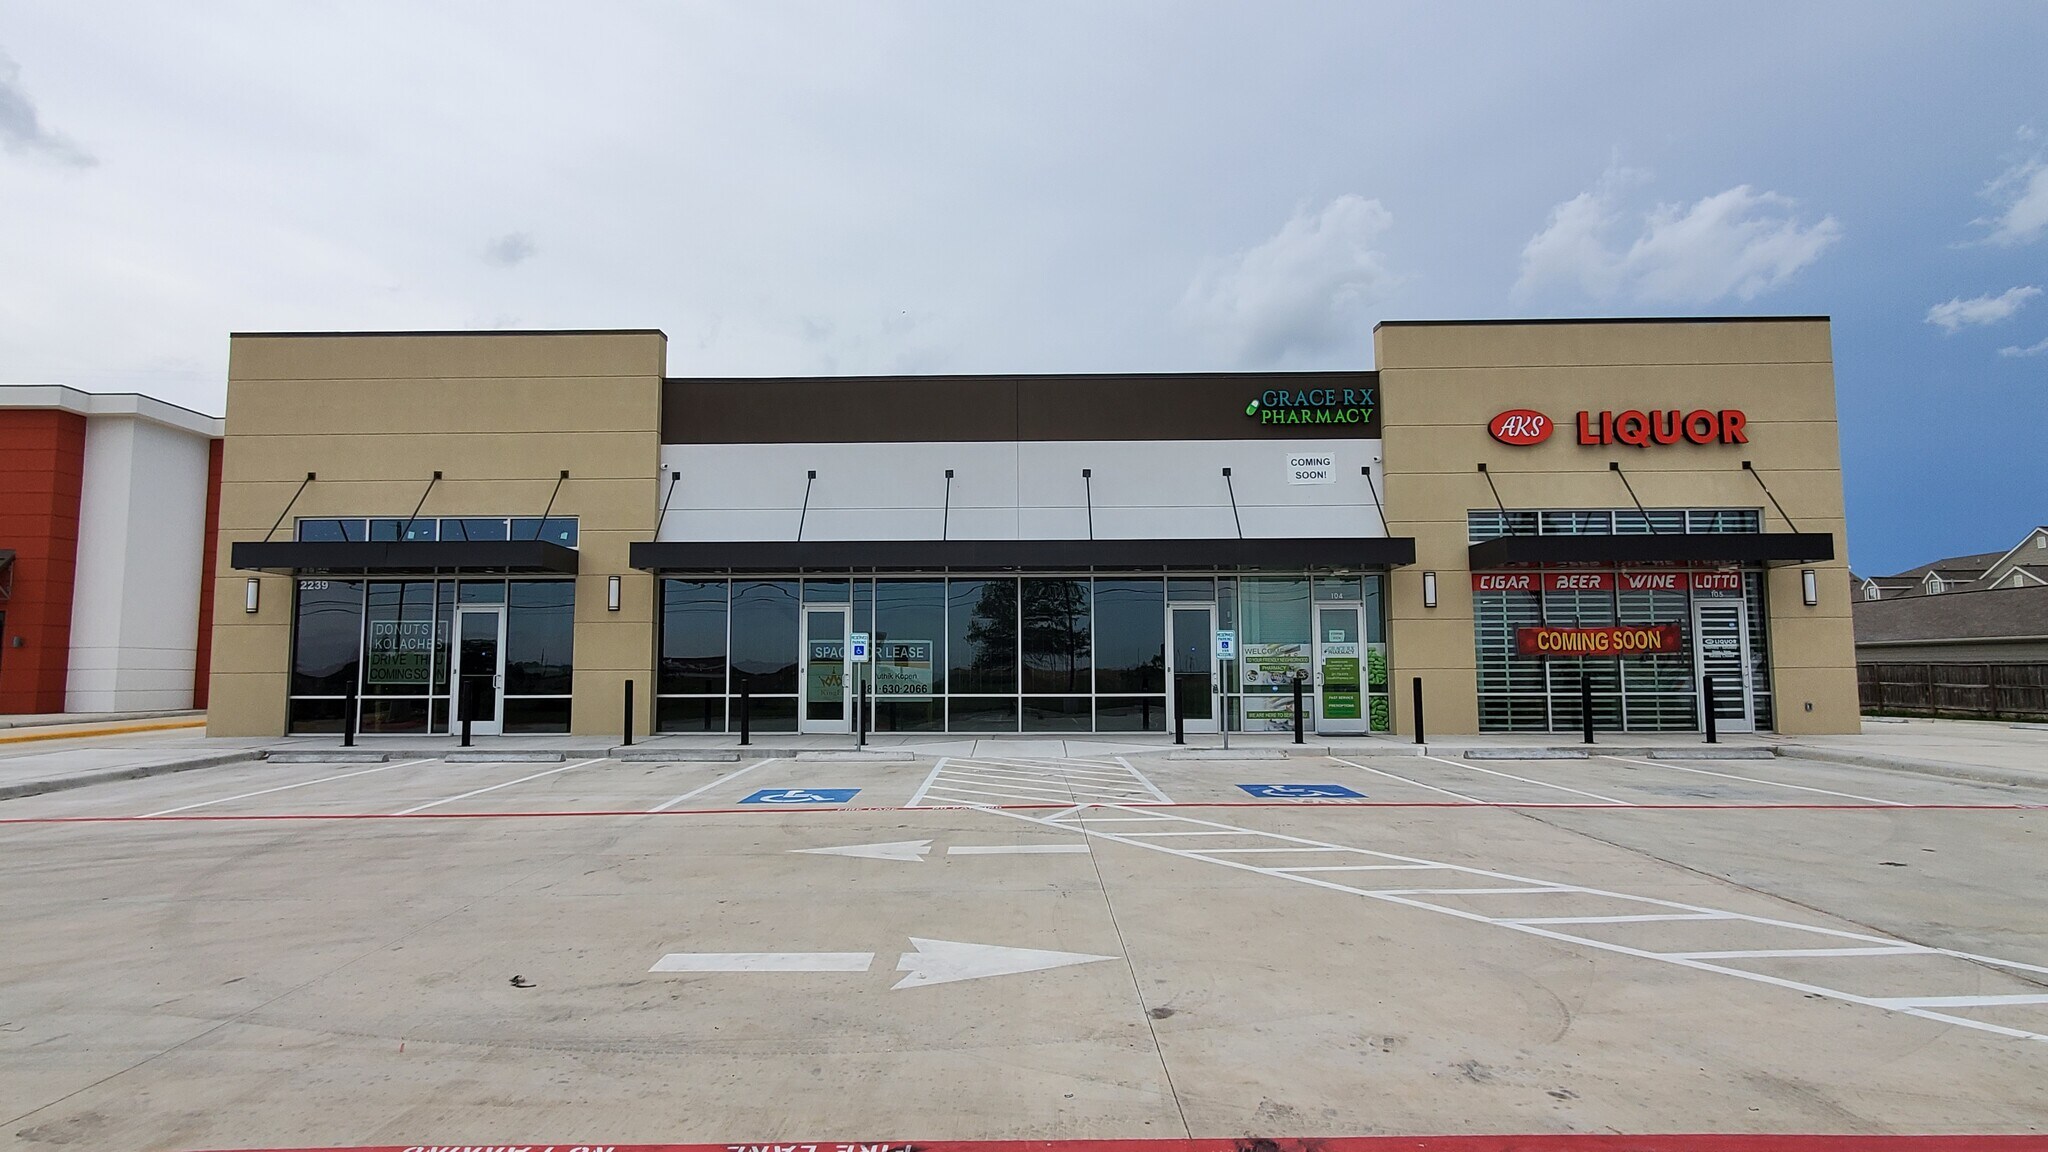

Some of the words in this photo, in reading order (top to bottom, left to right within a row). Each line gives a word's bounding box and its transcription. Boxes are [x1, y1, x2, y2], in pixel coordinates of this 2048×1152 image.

[1262, 390, 1336, 407] GRACE
[1343, 388, 1375, 406] RX
[1261, 408, 1373, 424] PHARMACY
[1498, 415, 1544, 437] AKS
[1576, 409, 1749, 448] LIQUOR
[1290, 458, 1331, 467] COMING
[1295, 471, 1327, 479] SOON!
[300, 580, 329, 590] 2239
[1480, 575, 1529, 589] CIGAR
[1556, 574, 1602, 589] BEER
[1629, 574, 1676, 589] WINE
[1695, 574, 1738, 588] LOTTO
[376, 624, 429, 635] DONUTS
[375, 638, 443, 649] KOLACHES
[1537, 631, 1609, 651] COMING
[1613, 630, 1661, 649] SOON
[815, 646, 845, 658] SPAC
[885, 646, 924, 658] LEASE
[371, 653, 406, 665] DRIVE
[414, 653, 443, 665] THU
[370, 668, 413, 680] COMING
[414, 668, 445, 680] SON
